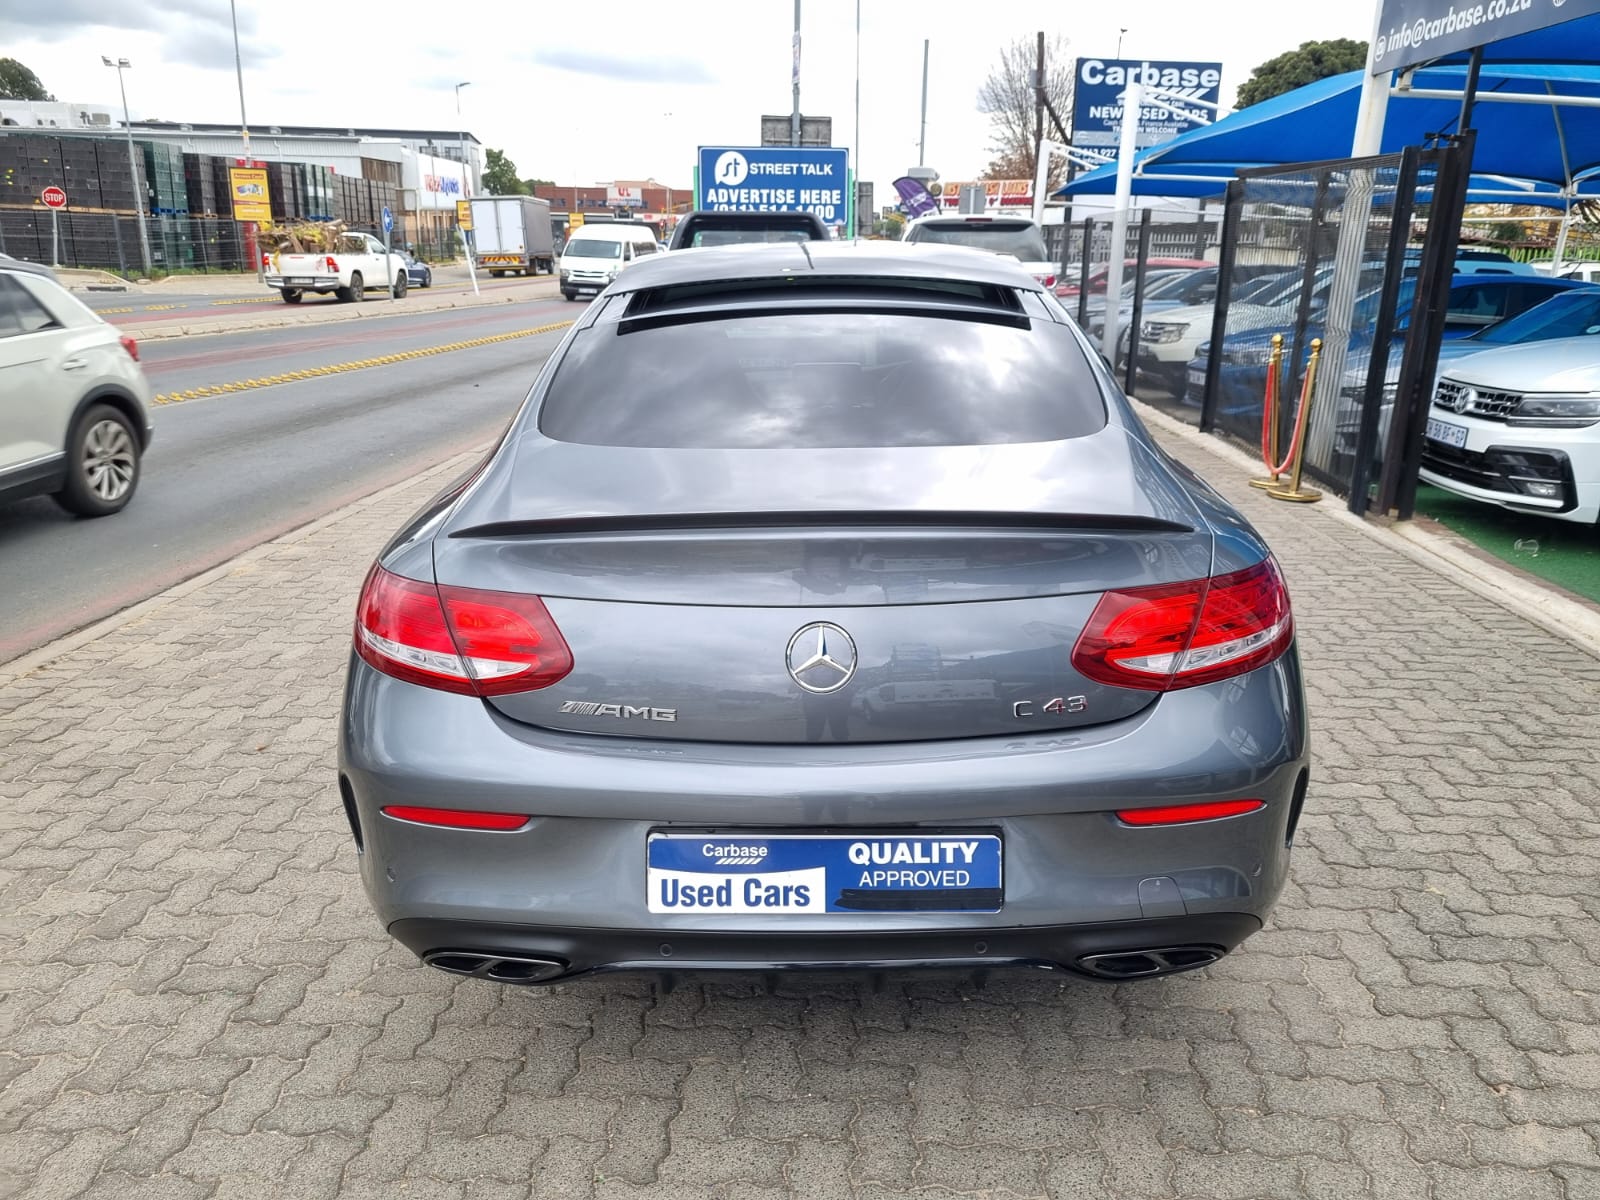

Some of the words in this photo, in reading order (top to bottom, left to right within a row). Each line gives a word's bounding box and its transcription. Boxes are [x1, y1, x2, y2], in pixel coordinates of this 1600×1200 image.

[1081, 60, 1220, 87] Carbase
[1089, 106, 1123, 119] NEW
[750, 162, 799, 175] STREET
[800, 163, 833, 175] TALK
[45, 193, 63, 203] STOP
[707, 188, 795, 203] ADVERTISE
[801, 189, 841, 204] HERE
[1013, 700, 1033, 718] C
[1043, 695, 1088, 714] 43
[702, 843, 768, 857] Carbase
[849, 841, 979, 866] QUALITY
[859, 870, 970, 887] APPROVED
[661, 878, 732, 908] Used
[743, 877, 811, 908] Cars
